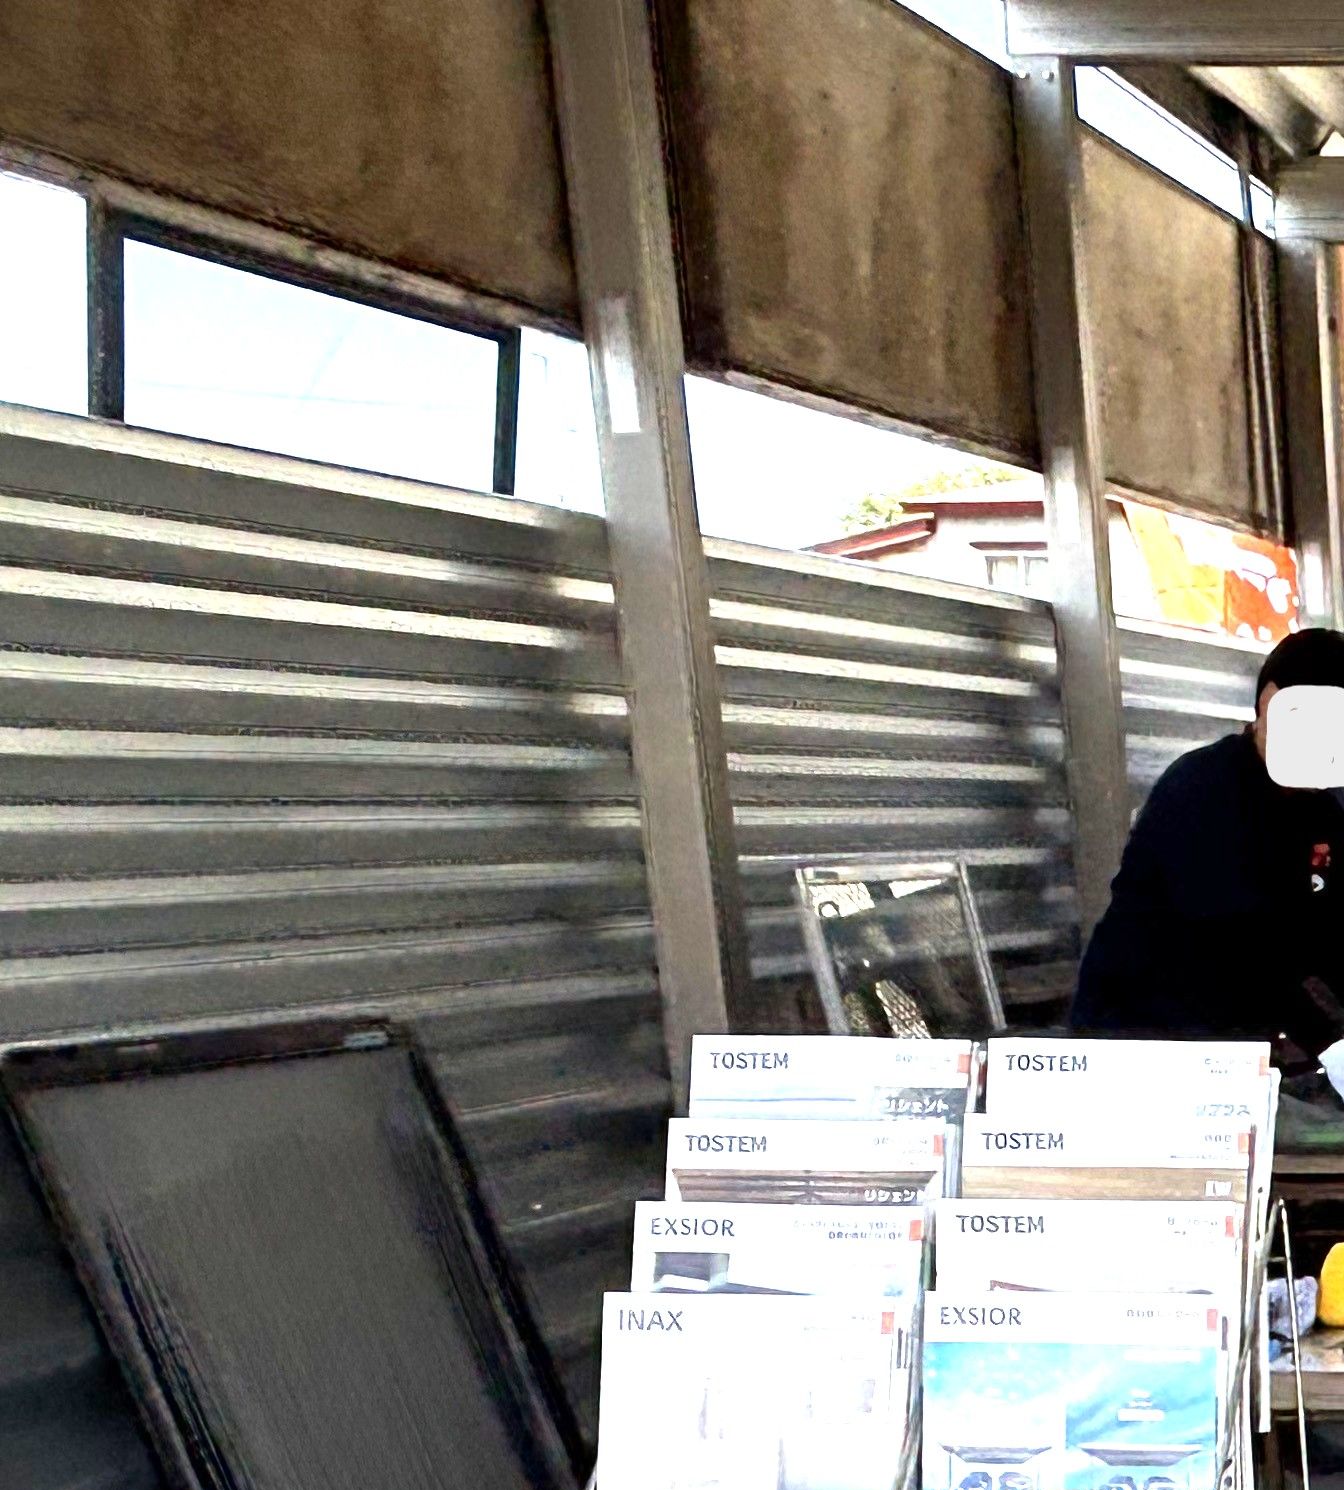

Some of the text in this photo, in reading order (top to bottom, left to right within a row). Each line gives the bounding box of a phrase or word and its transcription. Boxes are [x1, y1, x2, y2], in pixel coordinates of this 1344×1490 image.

[709, 1052, 789, 1070] TOSTEM
[1004, 1054, 1088, 1073] TOSTEM
[685, 1135, 767, 1153] TOSTEM
[981, 1132, 1064, 1151] TOSTEM
[650, 1219, 735, 1238] EXSIOR
[956, 1215, 1045, 1234] TOSTEM
[618, 1310, 684, 1333] INAX
[939, 1307, 1022, 1326] EXSIOR
